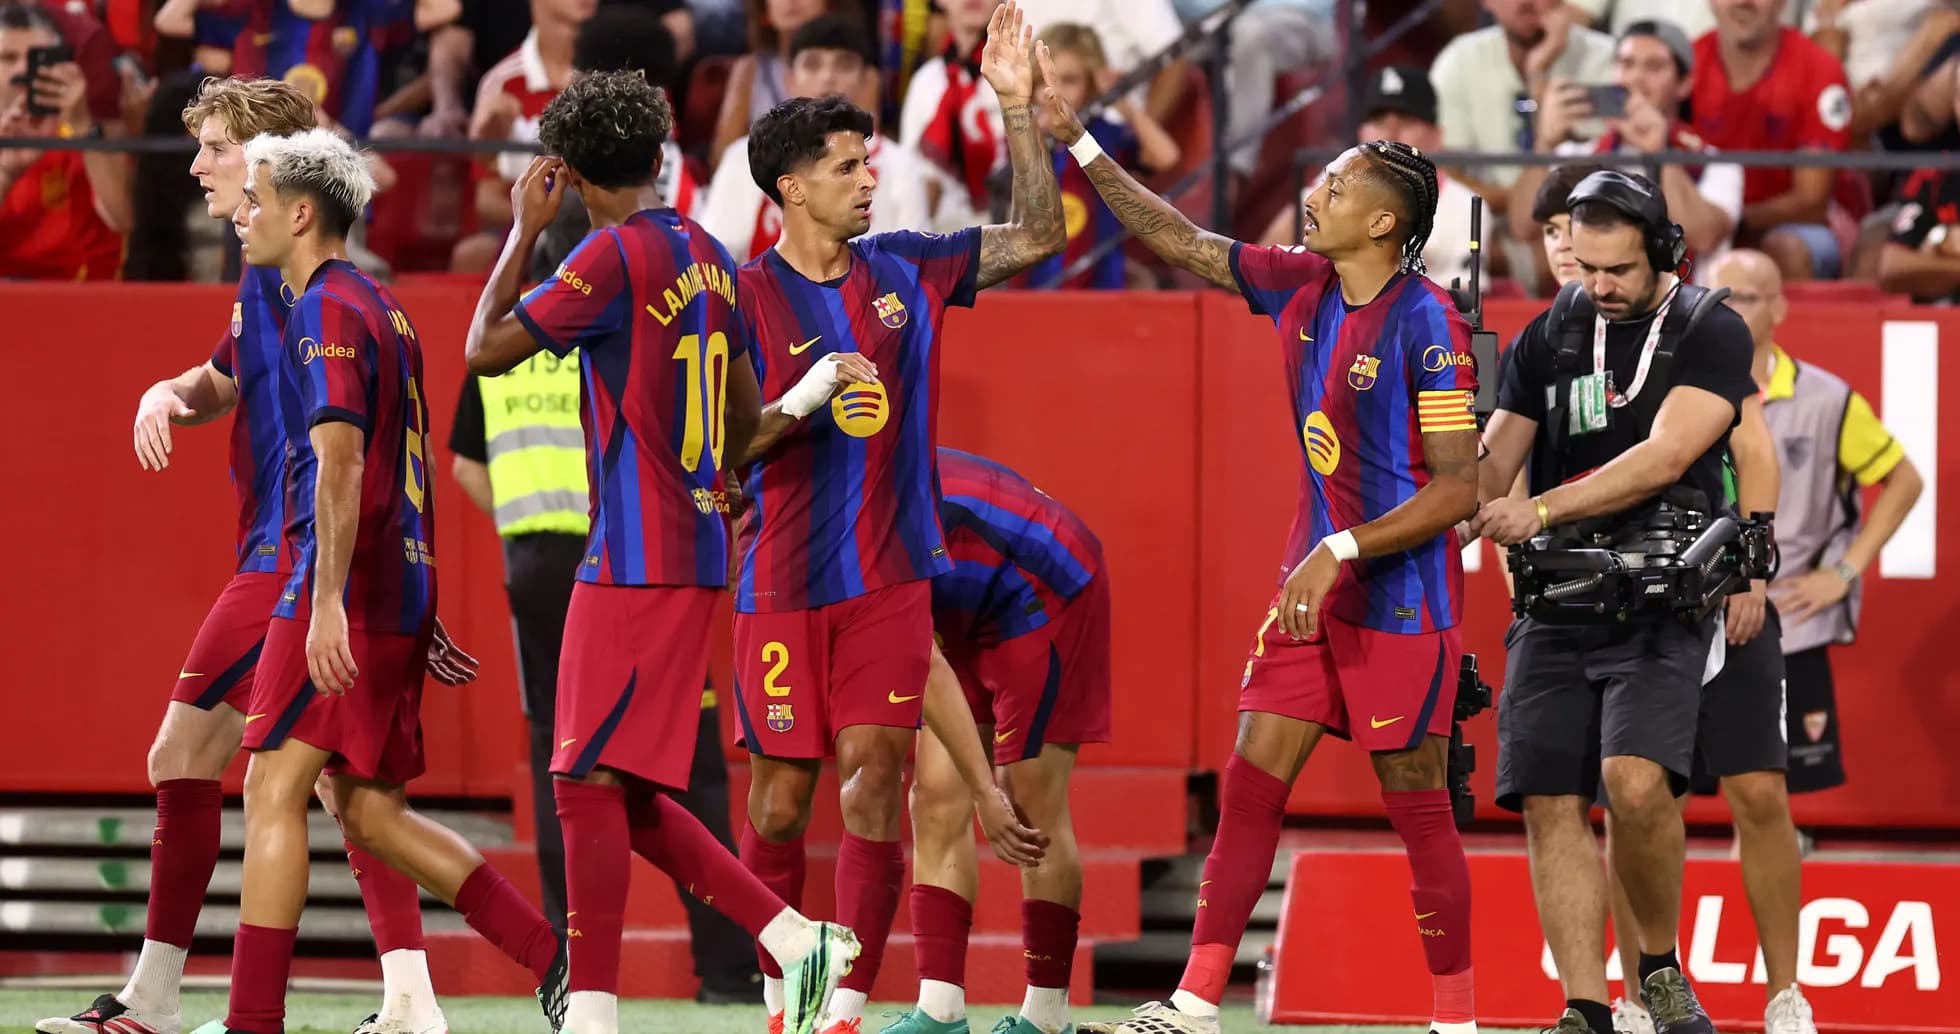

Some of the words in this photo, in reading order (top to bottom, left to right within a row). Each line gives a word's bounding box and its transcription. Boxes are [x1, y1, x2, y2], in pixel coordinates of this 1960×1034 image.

[298, 337, 356, 365] Midea
[671, 331, 729, 473] 10
[761, 641, 792, 697] 2
